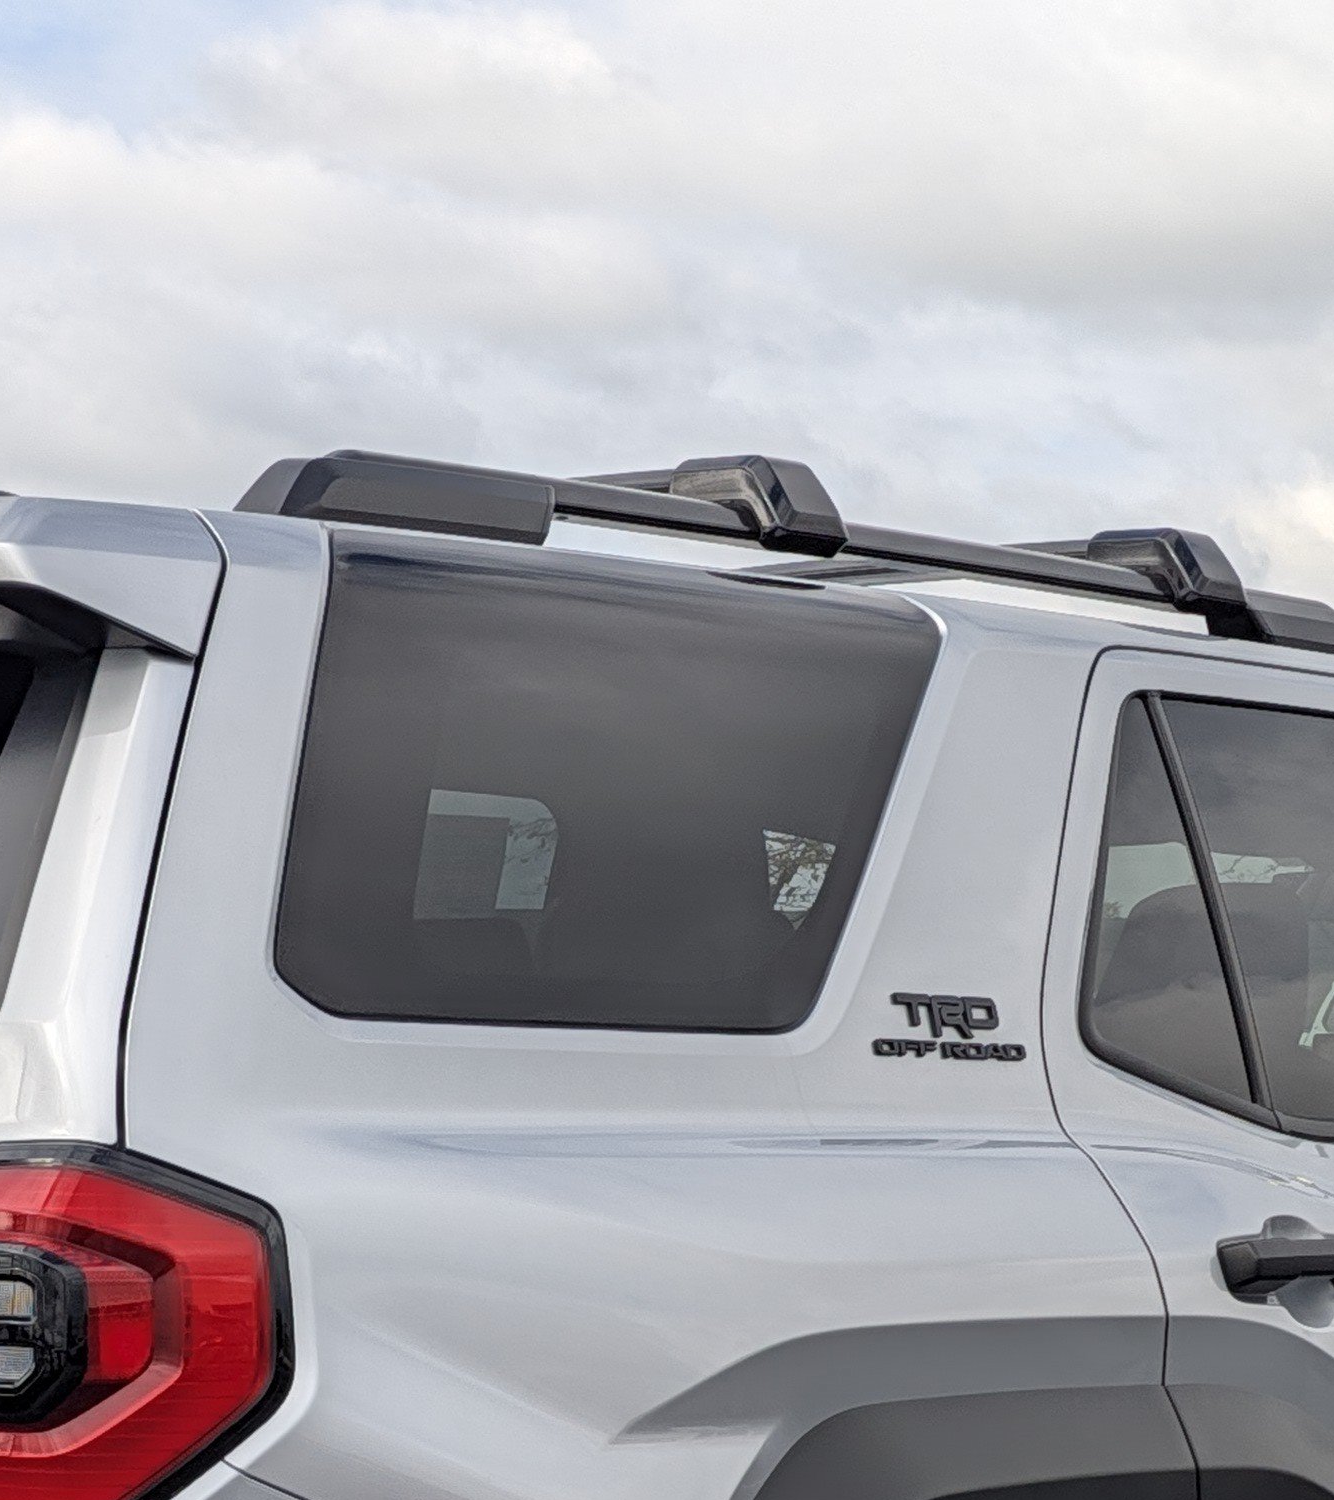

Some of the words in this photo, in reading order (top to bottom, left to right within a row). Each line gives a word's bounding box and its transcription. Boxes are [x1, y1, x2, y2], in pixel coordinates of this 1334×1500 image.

[890, 992, 1000, 1039] TRD
[871, 1038, 938, 1058] OFF
[940, 1042, 1027, 1061] ROAD
